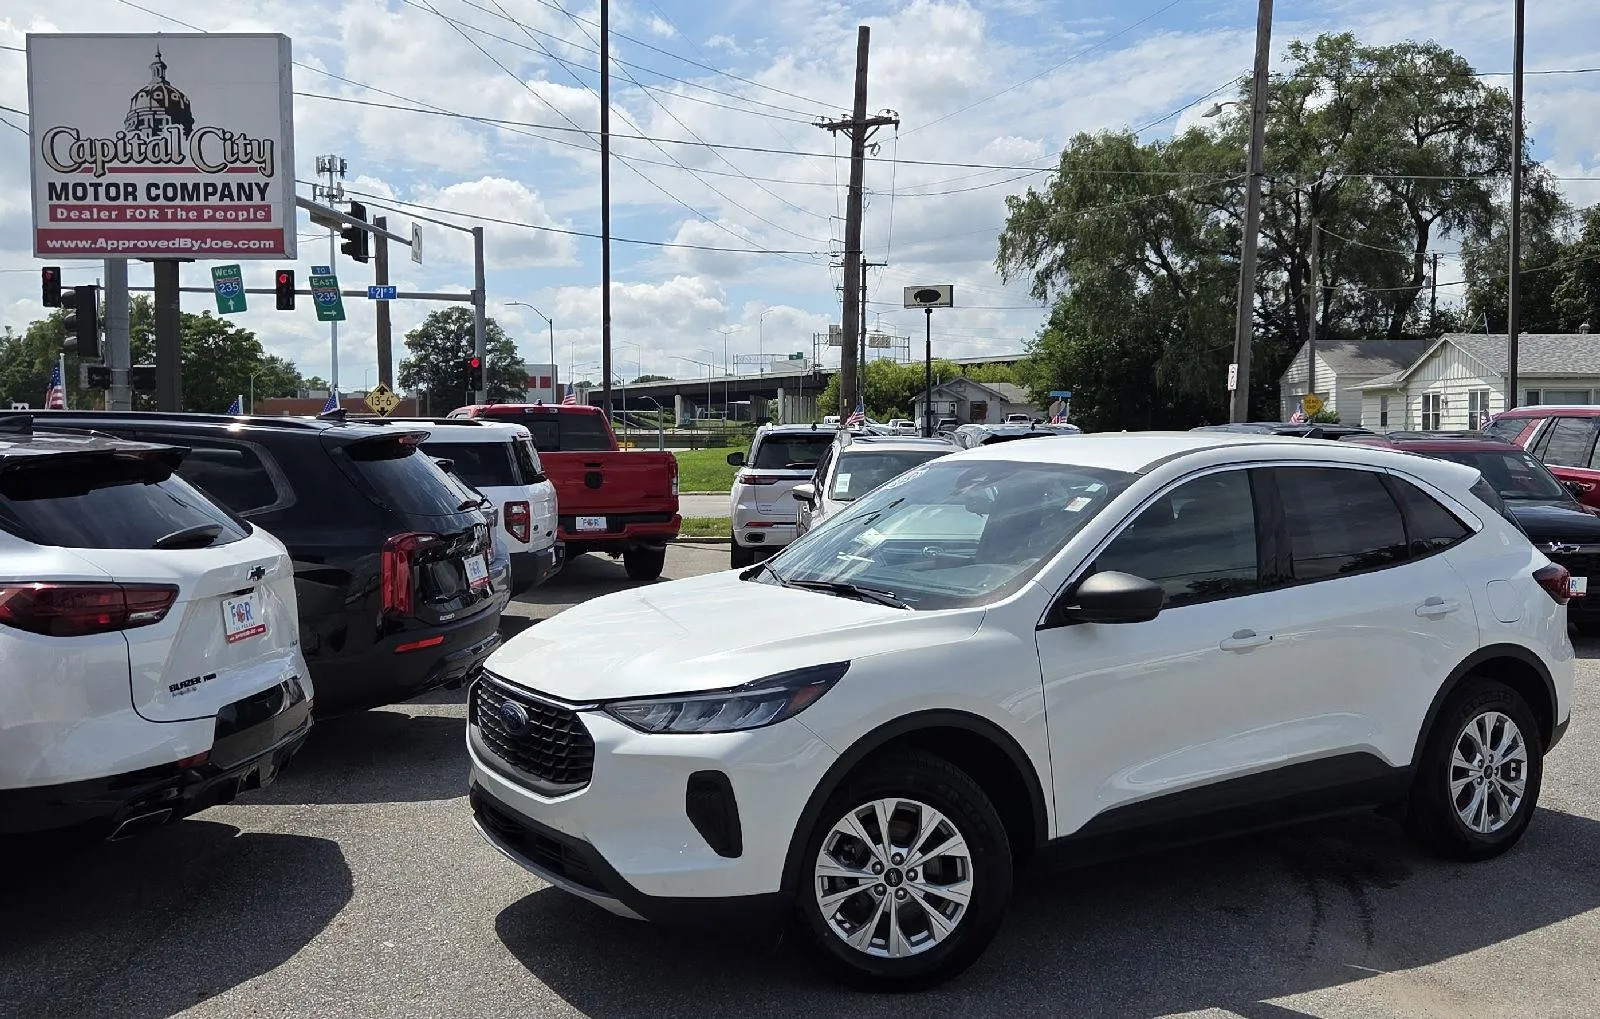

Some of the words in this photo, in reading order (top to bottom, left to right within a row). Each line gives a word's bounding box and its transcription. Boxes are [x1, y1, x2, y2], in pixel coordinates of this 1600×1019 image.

[42, 126, 185, 178] Capital
[190, 126, 274, 178] City
[48, 182, 138, 202] MOTOR
[146, 182, 270, 202] COMPANY
[56, 208, 118, 220] Dealer
[126, 208, 160, 220] FOR
[165, 208, 197, 220] The
[203, 208, 265, 221] People
[46, 238, 275, 250] www.ApprovedByJoe.com
[214, 268, 238, 277] WEST
[219, 282, 239, 293] 235
[312, 278, 334, 286] EAST
[317, 292, 337, 302] 235
